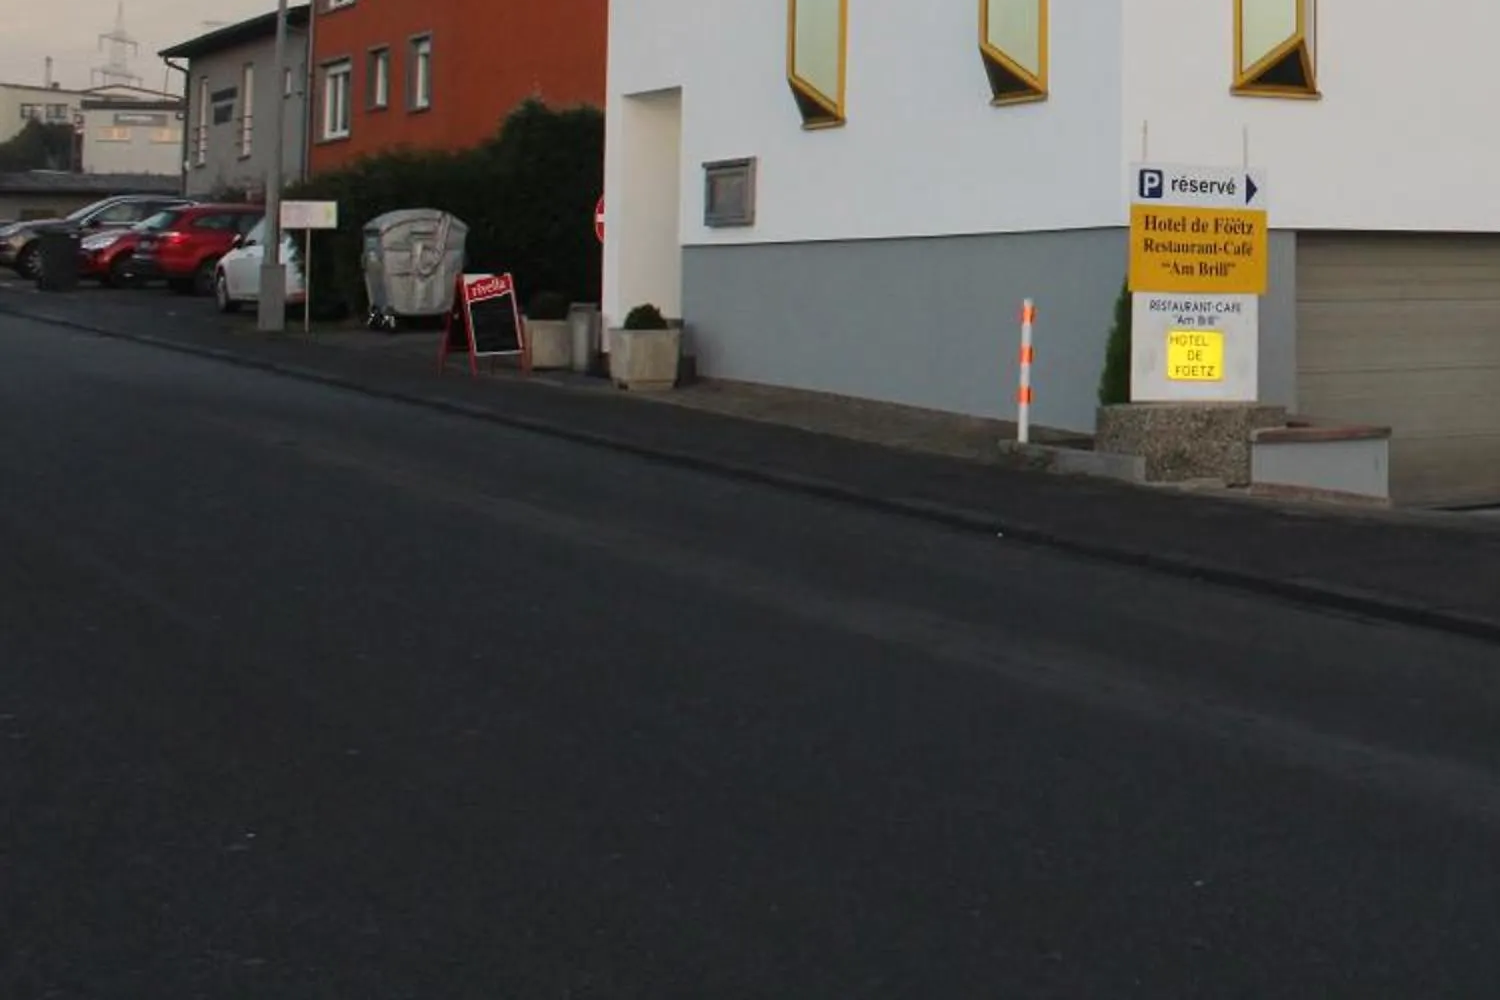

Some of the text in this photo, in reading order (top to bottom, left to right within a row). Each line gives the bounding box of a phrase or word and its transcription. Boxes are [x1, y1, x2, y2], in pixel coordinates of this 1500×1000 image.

[1144, 172, 1236, 196] P réservé
[1144, 215, 1186, 233] Hotel
[1192, 217, 1208, 233] de
[1170, 335, 1209, 347] HOTEL
[1187, 349, 1203, 361] DE
[1175, 365, 1216, 377] FOETZ
